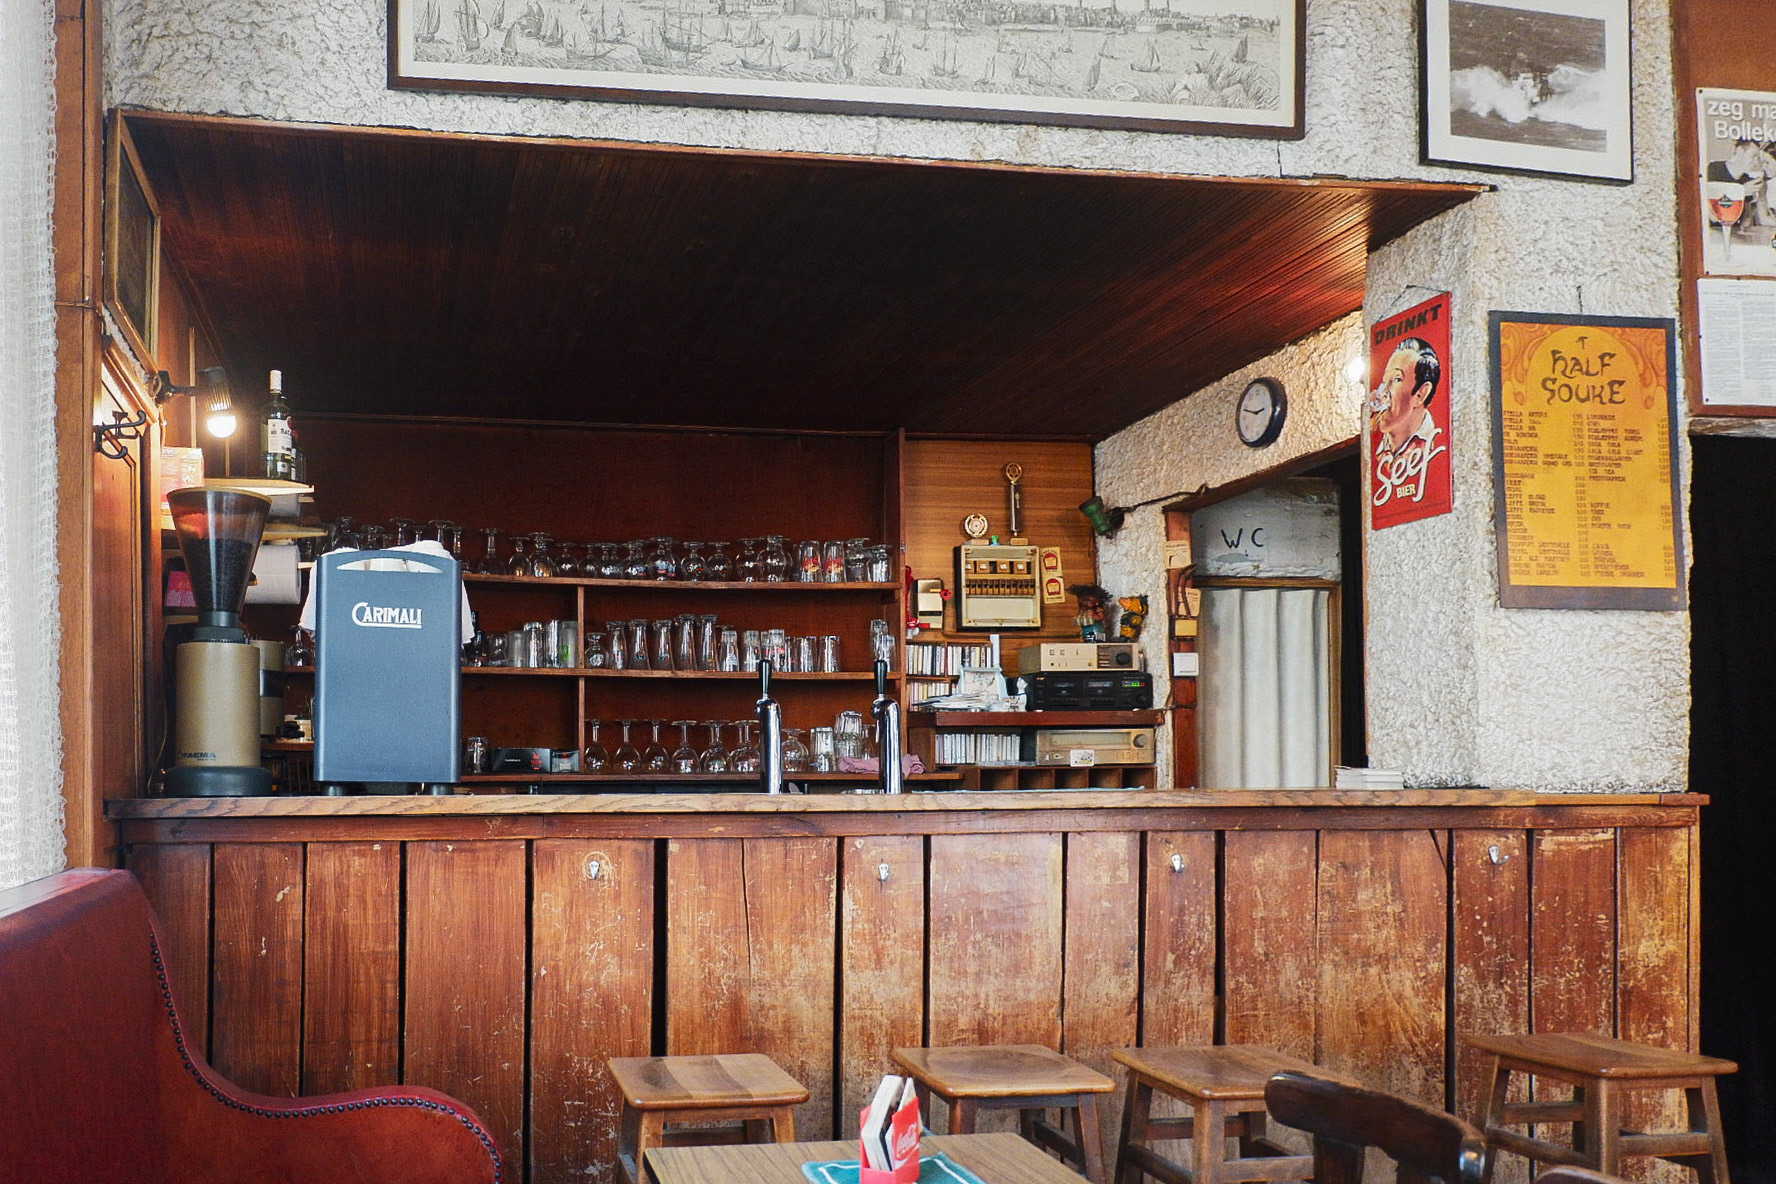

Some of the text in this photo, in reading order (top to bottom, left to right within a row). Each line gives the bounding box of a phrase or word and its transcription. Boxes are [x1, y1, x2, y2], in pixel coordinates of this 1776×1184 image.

[1707, 101, 1743, 121] zeg
[1375, 303, 1443, 345] DRINKT
[1541, 377, 1626, 405] SOUKE
[1397, 484, 1416, 498] BIER
[352, 602, 422, 629] CARIMALI
